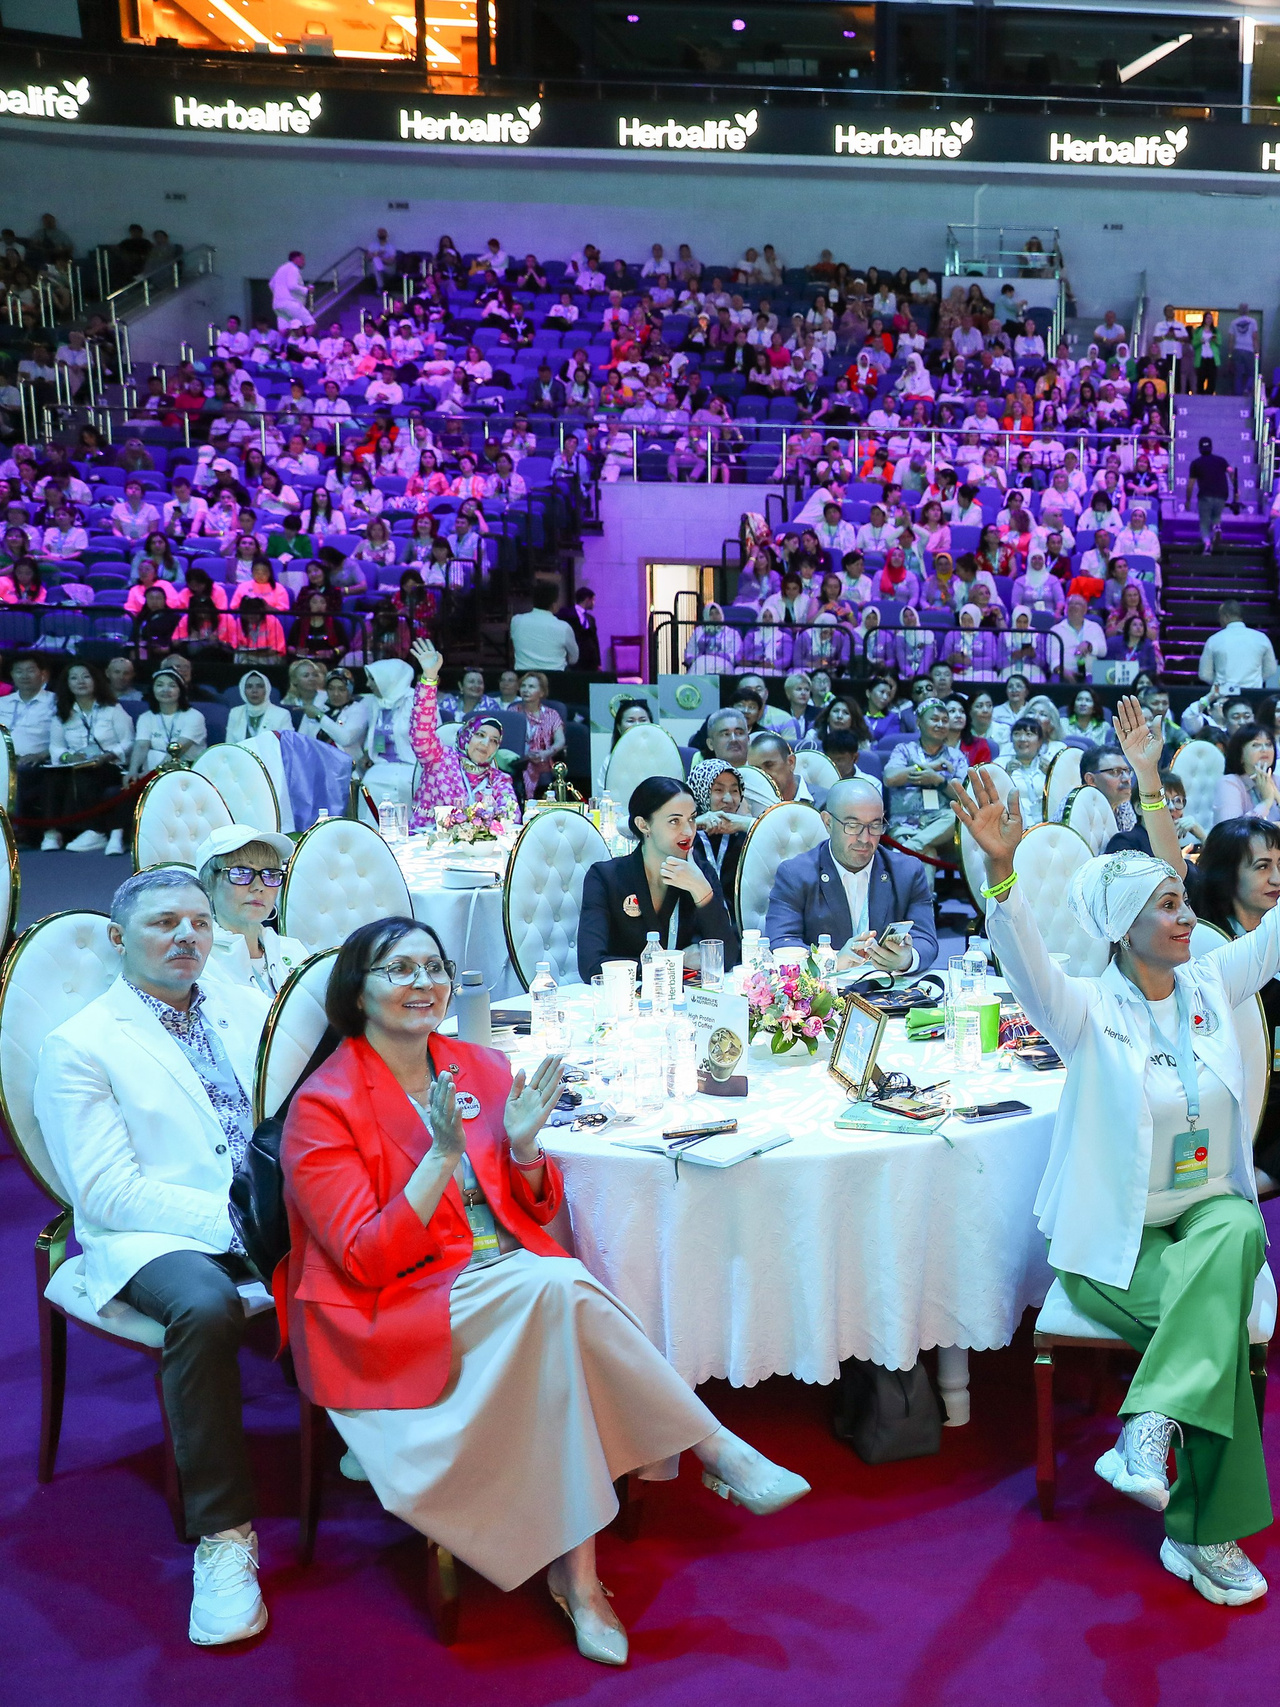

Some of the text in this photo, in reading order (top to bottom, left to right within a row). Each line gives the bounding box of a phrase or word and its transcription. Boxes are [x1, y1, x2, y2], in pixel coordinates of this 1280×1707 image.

[174, 96, 310, 134] Herbalife
[400, 109, 530, 144] Herbalife
[618, 117, 746, 151] Herbalife
[834, 125, 962, 158] Herbalife
[1050, 133, 1177, 166] Herbalife
[667, 961, 676, 1001] Herbalife
[699, 1014, 716, 1023] Protein
